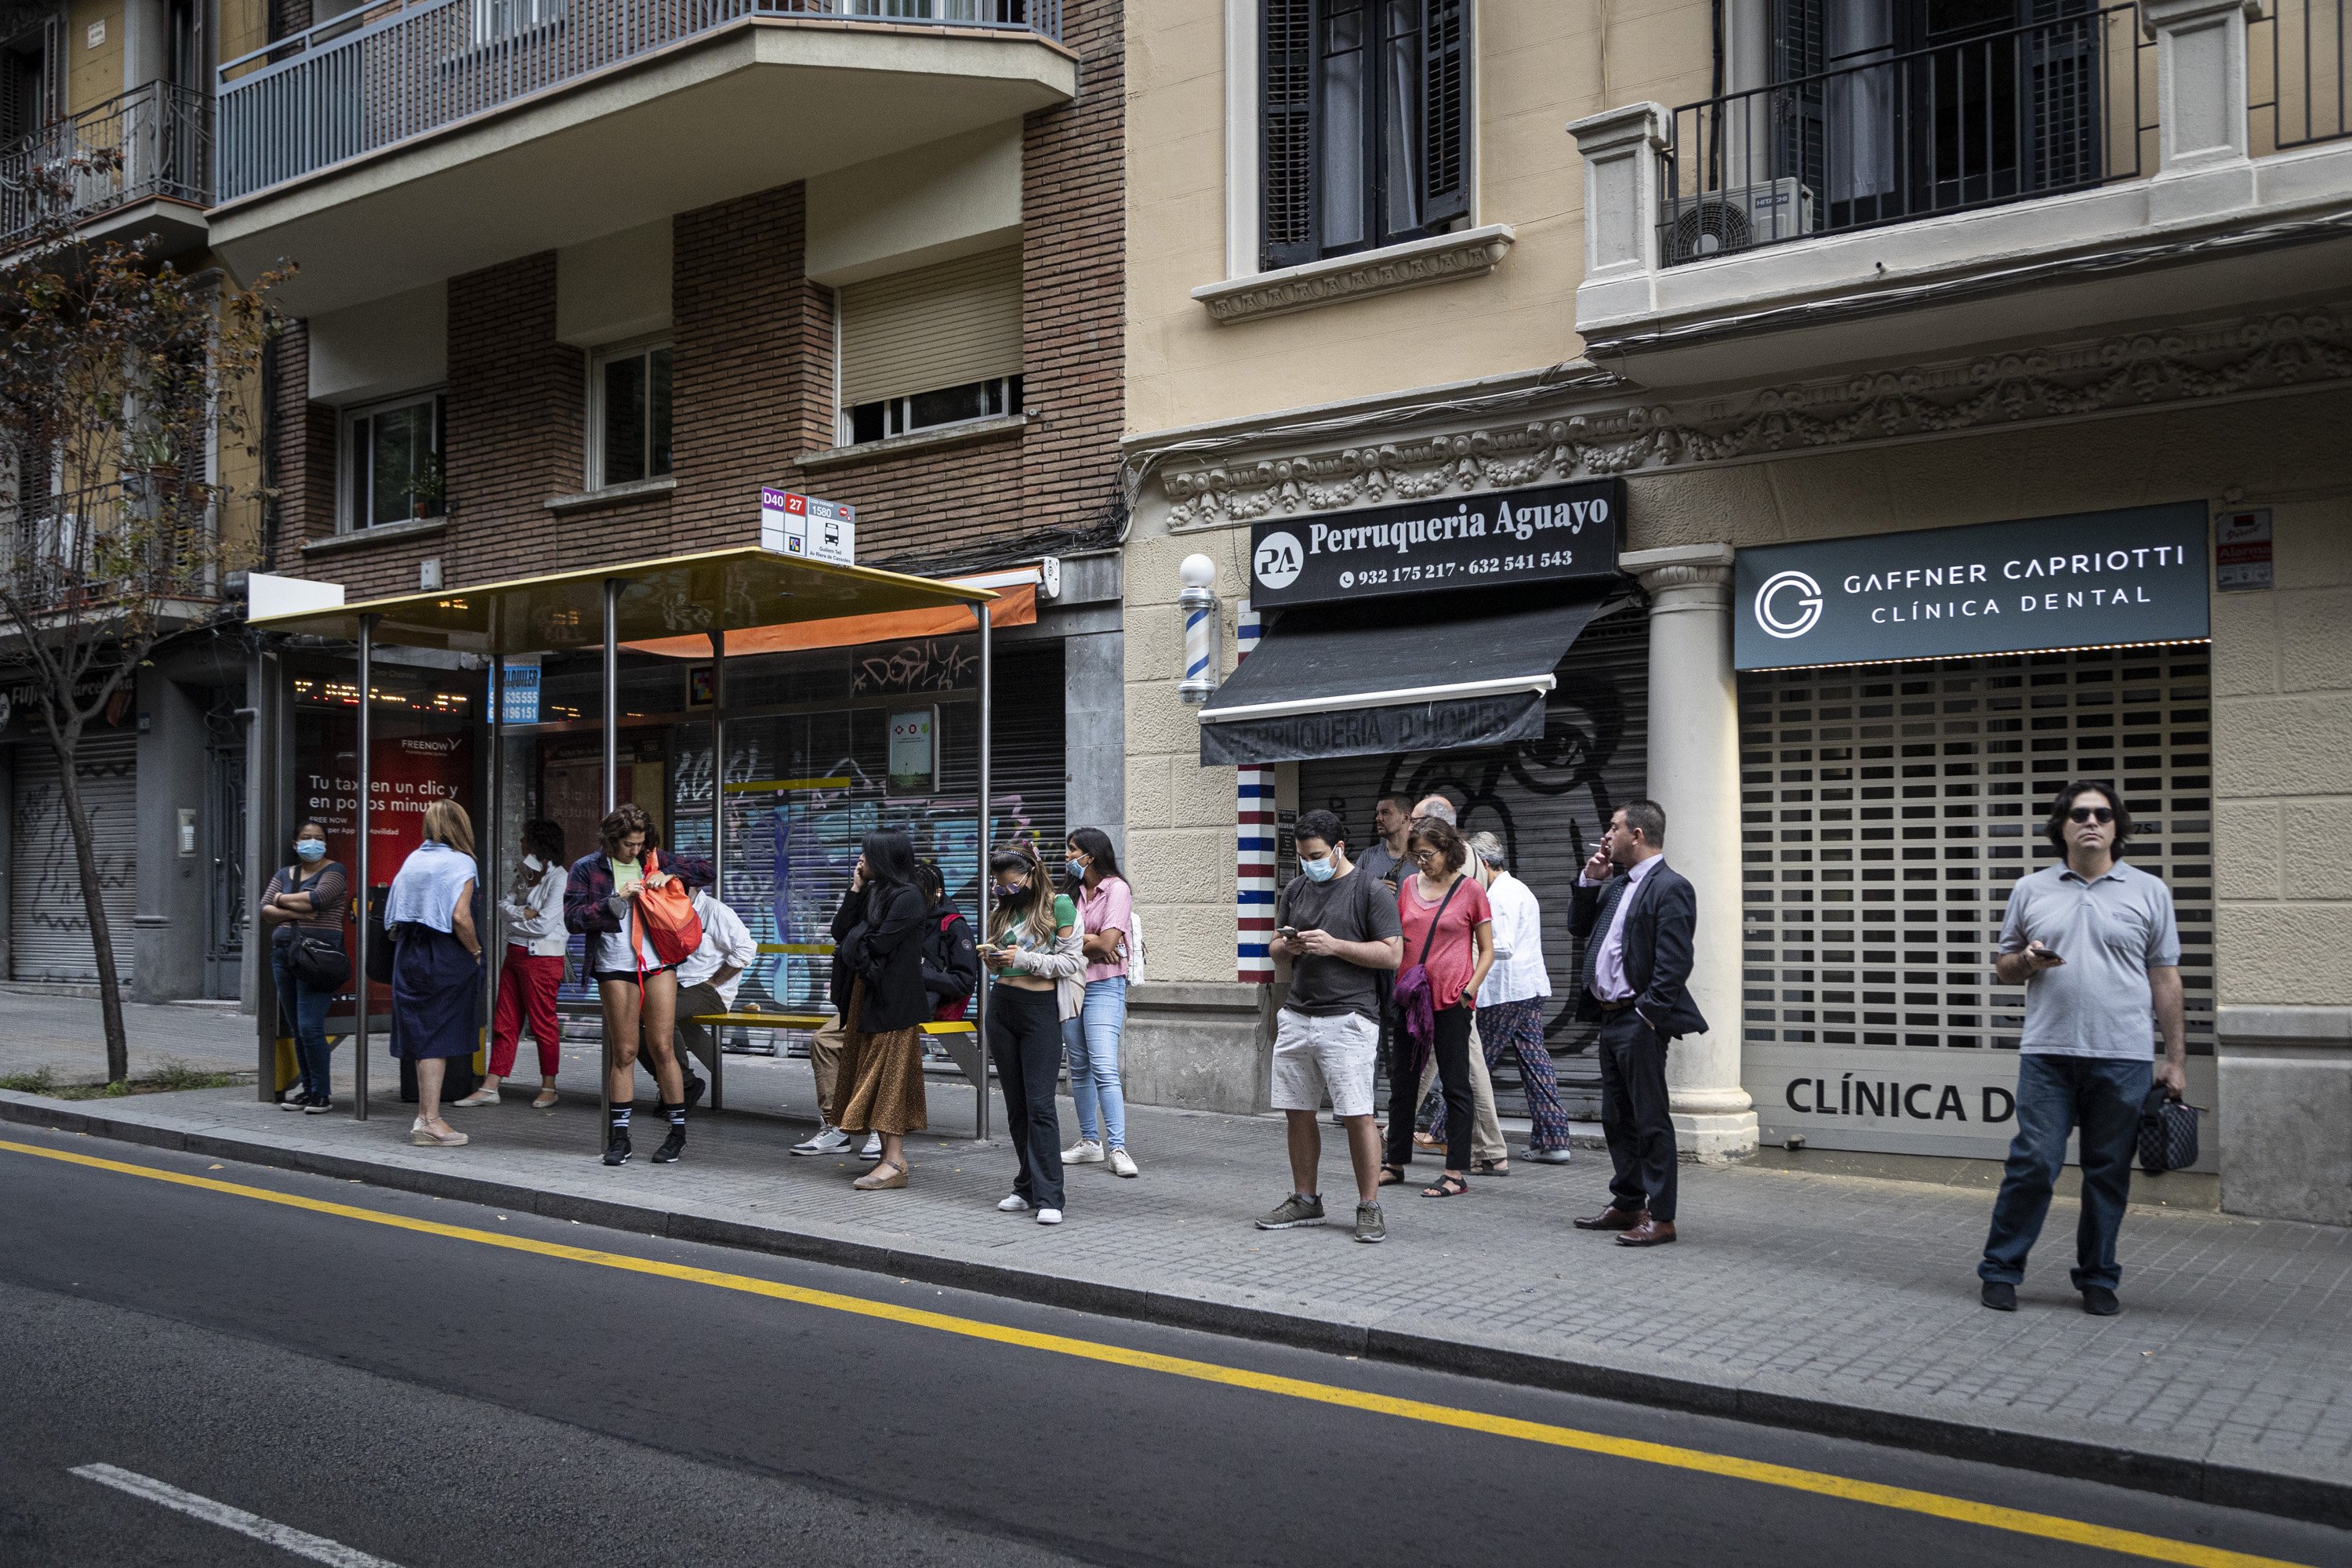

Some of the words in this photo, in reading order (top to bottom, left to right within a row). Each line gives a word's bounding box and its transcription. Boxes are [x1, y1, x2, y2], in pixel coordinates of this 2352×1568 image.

[764, 492, 783, 506] D40
[789, 499, 802, 510] 27
[812, 506, 831, 517] 1580
[1309, 503, 1486, 554] Perruqueria
[1493, 499, 1609, 540] Aguayo
[1259, 546, 1299, 575] PA
[1359, 569, 1388, 586] 932
[1392, 566, 1421, 583] 175
[1425, 563, 1456, 579] 217
[1468, 557, 1500, 575] 632
[1504, 554, 1534, 571] 541
[1541, 550, 1573, 568] 543
[1844, 564, 1987, 593] GAFFNER
[2003, 545, 2183, 579] CAPRIOTTI
[1871, 599, 2000, 623] CLÍNICA
[2021, 586, 2151, 612] DENTAL
[401, 739, 448, 751] FREENOW
[309, 775, 329, 789] Tu
[336, 778, 359, 791] tax
[371, 782, 390, 793] en
[396, 783, 413, 793] un
[418, 780, 445, 795] clic
[449, 786, 458, 799] y
[309, 797, 330, 808] en
[336, 798, 385, 811] poos
[1786, 1073, 1967, 1121] CLÍNICA
[1983, 1087, 2015, 1123] D
